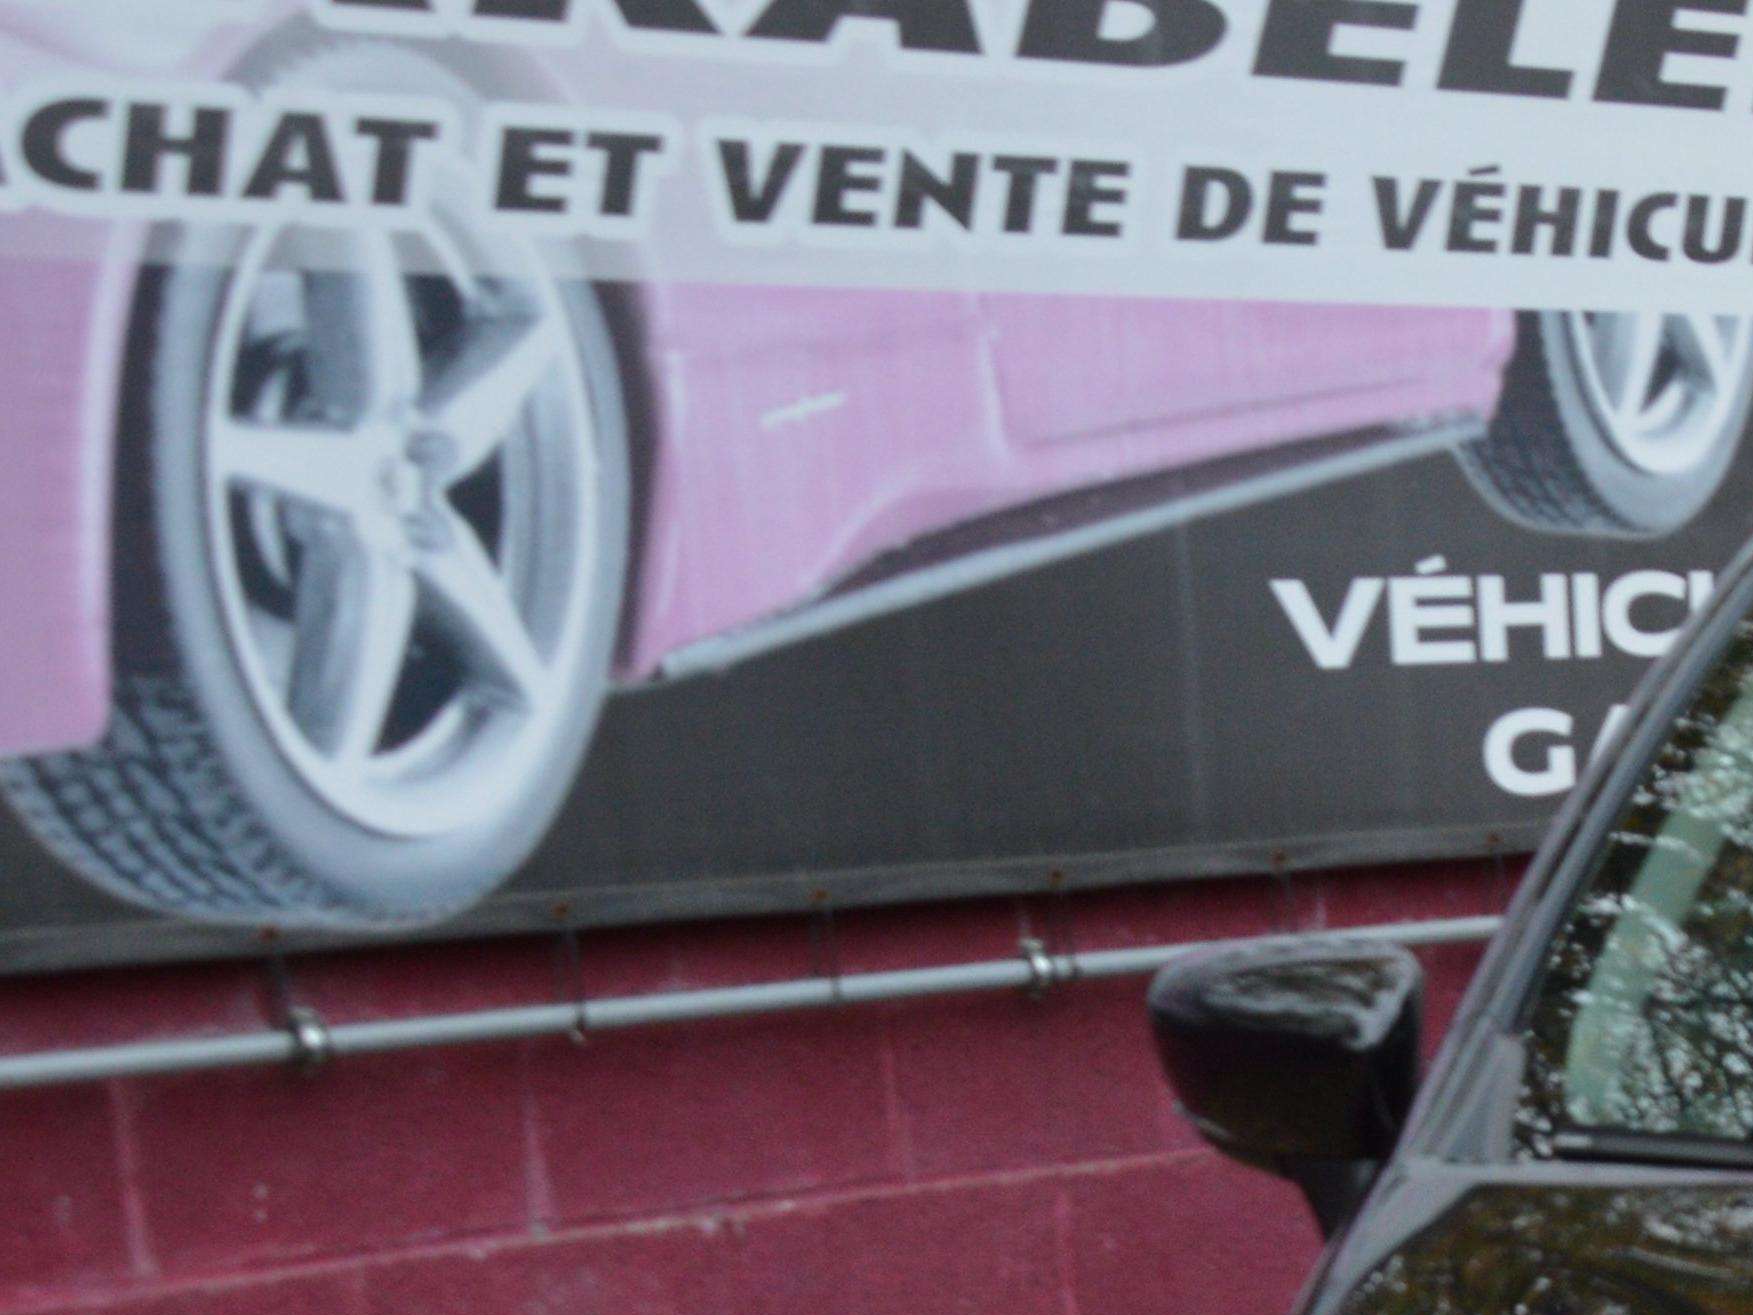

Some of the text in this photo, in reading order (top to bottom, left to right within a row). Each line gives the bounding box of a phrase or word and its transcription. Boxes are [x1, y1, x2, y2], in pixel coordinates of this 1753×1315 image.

[0, 97, 440, 206] CHAT
[495, 127, 663, 216] ET
[717, 138, 1130, 237] VENTE
[1175, 165, 1328, 245] DE
[1269, 555, 1715, 670] VÉHIC
[1482, 704, 1630, 797] G
